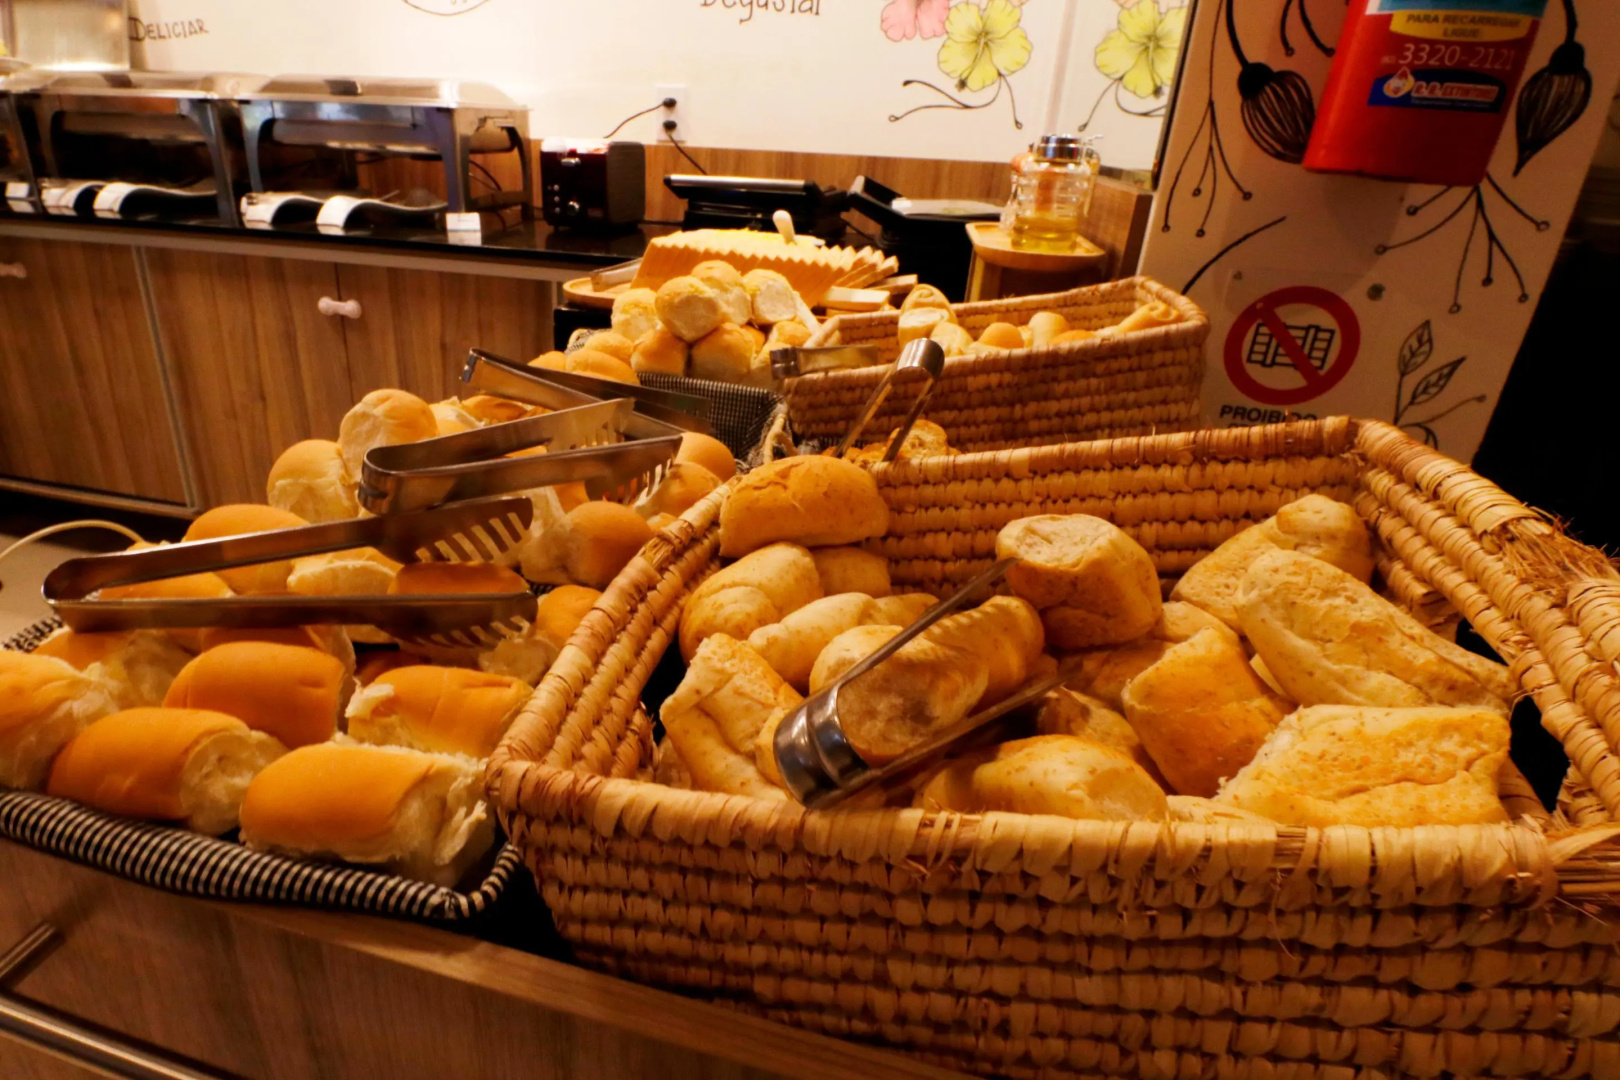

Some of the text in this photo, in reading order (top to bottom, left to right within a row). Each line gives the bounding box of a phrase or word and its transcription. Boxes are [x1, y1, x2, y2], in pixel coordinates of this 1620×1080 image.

[128, 16, 209, 41] DELICIAR
[1405, 13, 1439, 24] PARA
[1398, 43, 1515, 70] 3320-2121
